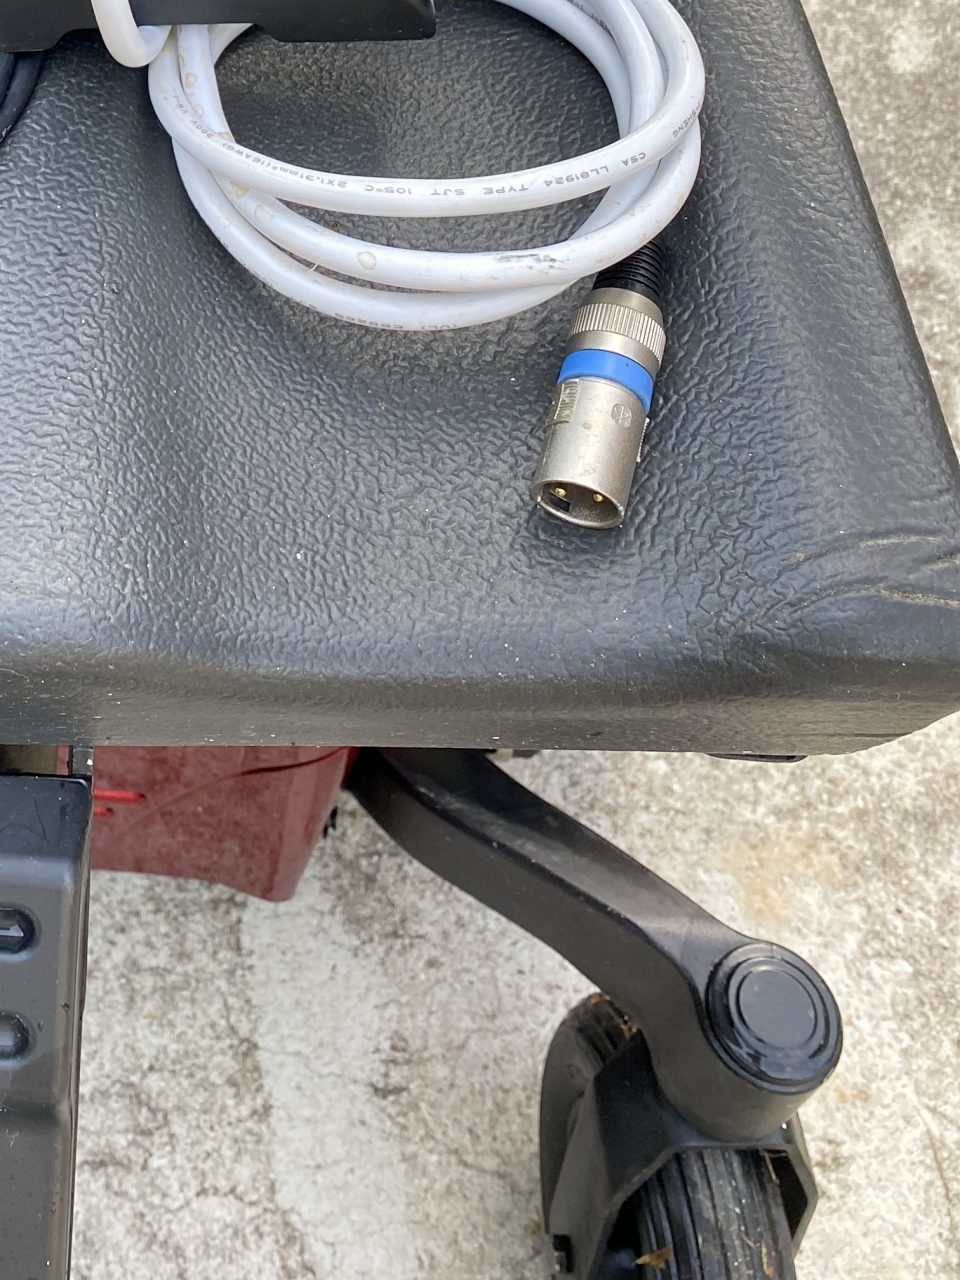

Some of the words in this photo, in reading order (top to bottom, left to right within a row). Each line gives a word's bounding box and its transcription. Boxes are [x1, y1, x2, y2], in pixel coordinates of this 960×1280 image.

[620, 151, 646, 168] CSA
[430, 187, 465, 196] SJT
[483, 183, 529, 195] TYPE
